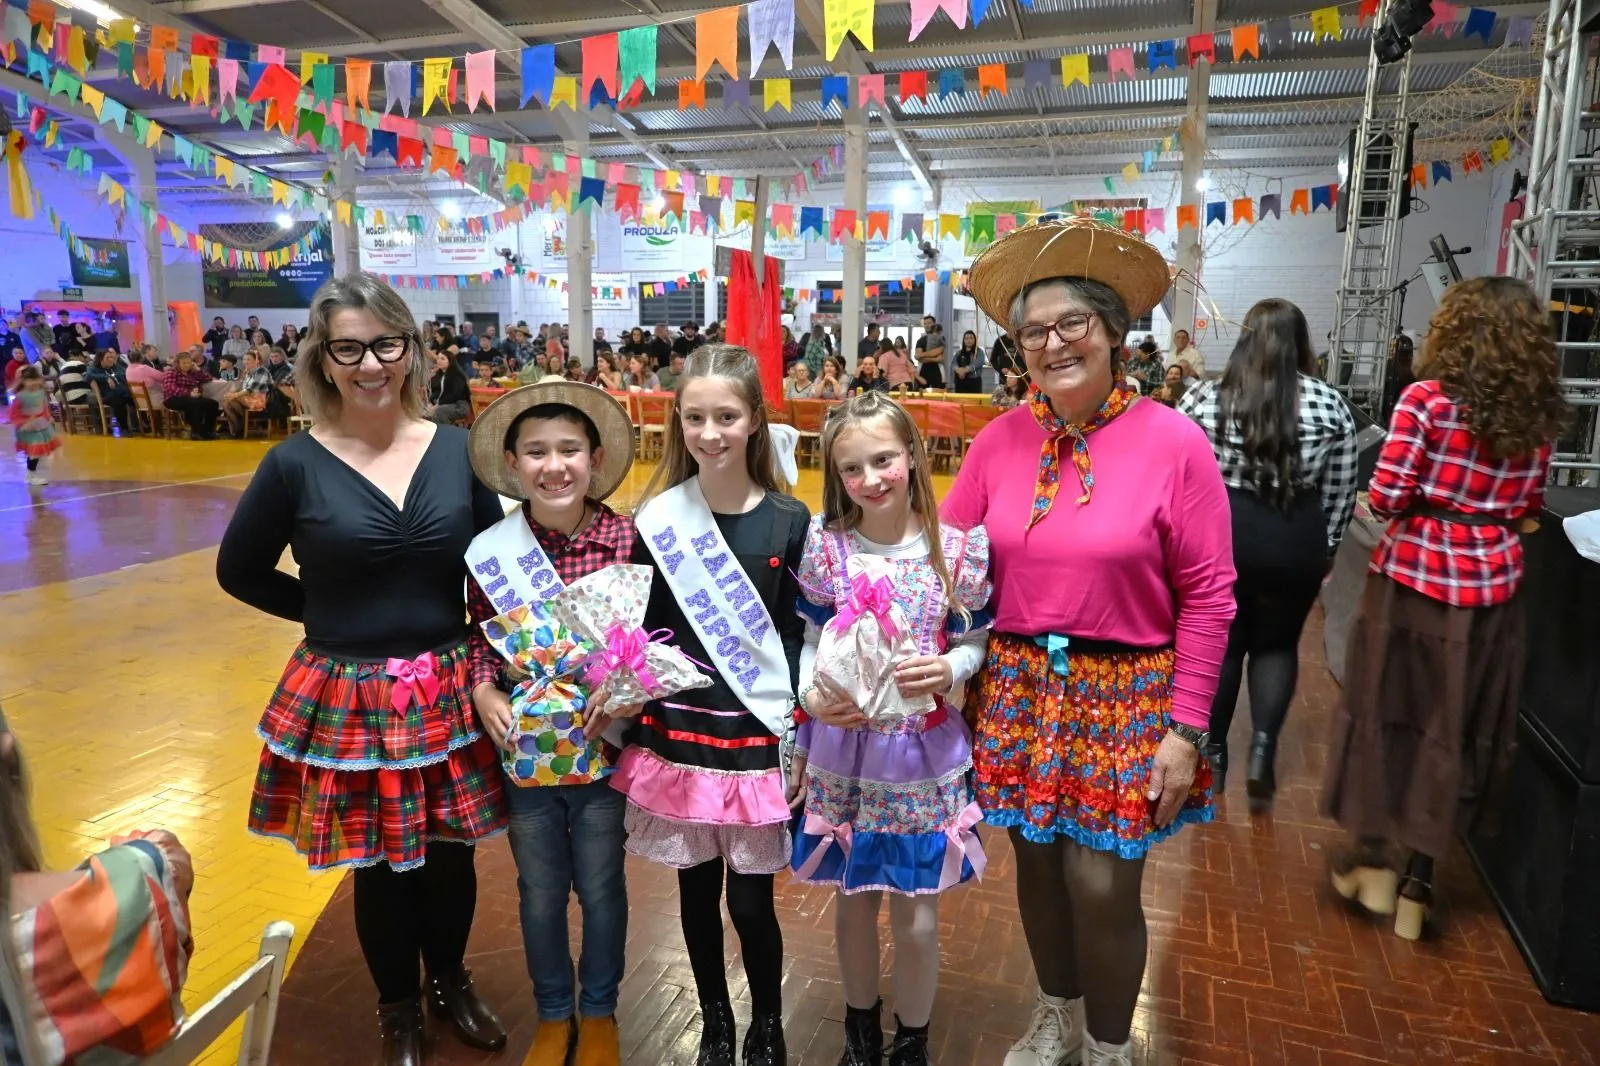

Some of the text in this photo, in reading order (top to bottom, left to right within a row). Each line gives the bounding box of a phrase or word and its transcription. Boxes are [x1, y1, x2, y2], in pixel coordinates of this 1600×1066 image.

[624, 226, 679, 237] PRODUZA
[474, 556, 524, 614] PIN
[517, 547, 565, 600] REI
[690, 530, 770, 647] RAINHA
[652, 525, 761, 693] DA PIPOCA
